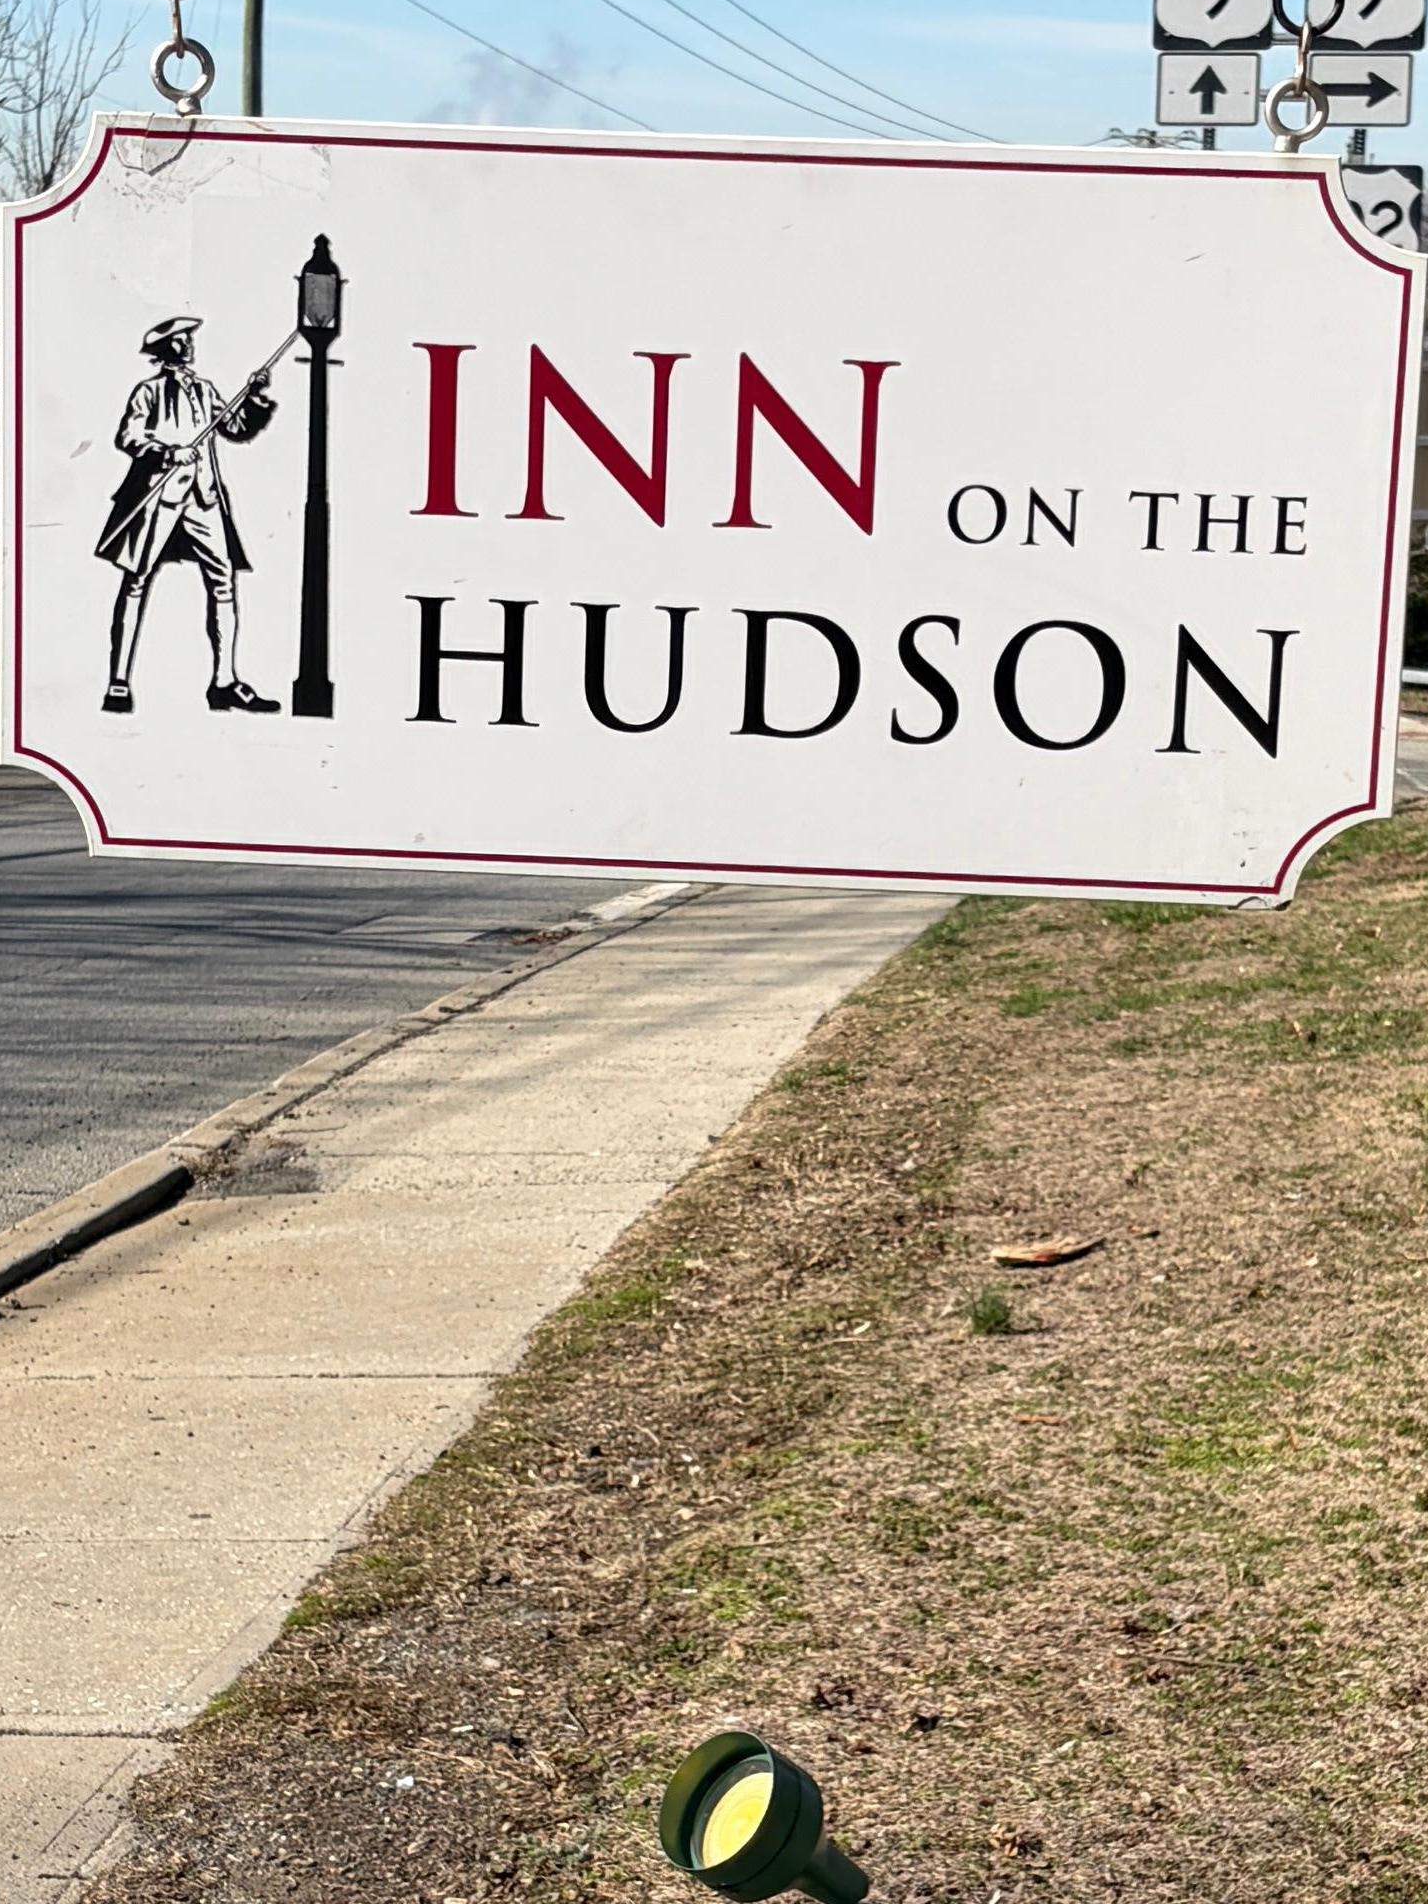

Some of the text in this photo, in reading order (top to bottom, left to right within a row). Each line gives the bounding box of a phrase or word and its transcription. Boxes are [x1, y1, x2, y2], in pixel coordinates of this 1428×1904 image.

[410, 343, 1307, 555] INN ON THE
[405, 595, 1299, 758] HUDSON
